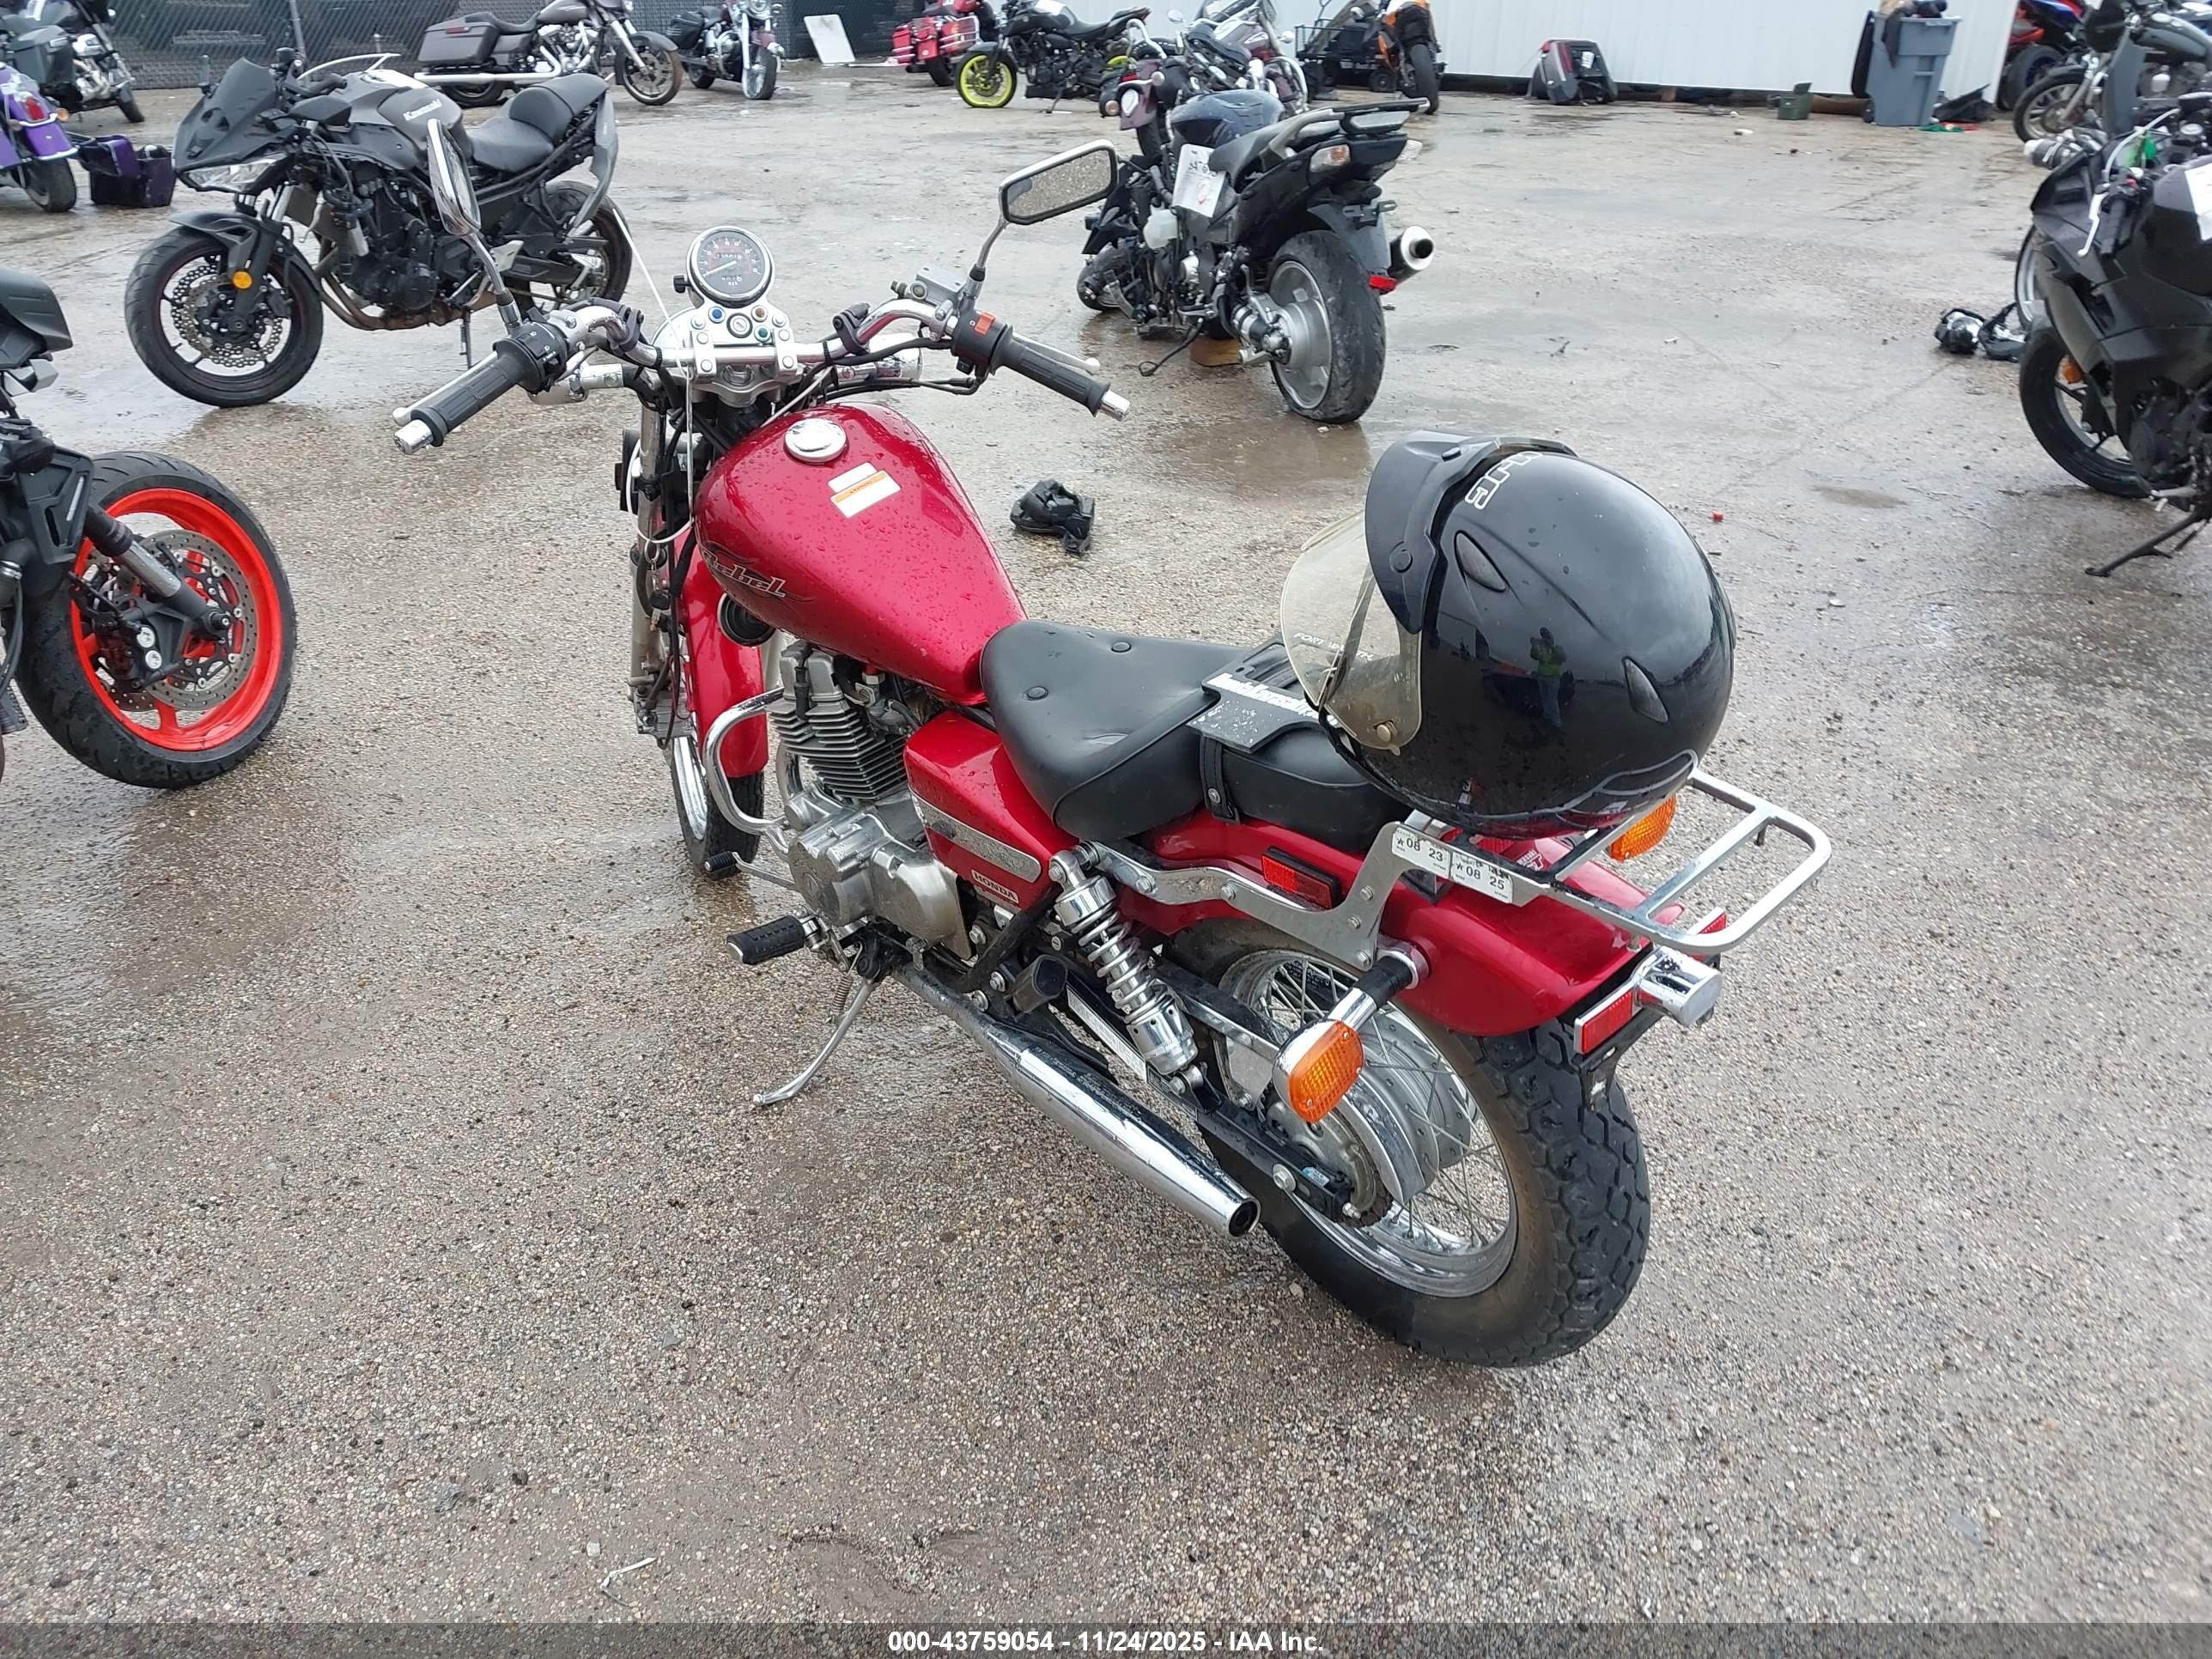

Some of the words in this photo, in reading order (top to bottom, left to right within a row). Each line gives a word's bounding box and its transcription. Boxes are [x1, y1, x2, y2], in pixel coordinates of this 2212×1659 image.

[702, 544, 787, 598] Rebel
[1407, 837, 1420, 852] 08
[1429, 848, 1443, 862] 23
[974, 872, 1018, 902] HONDA
[1466, 866, 1481, 880] 08
[1489, 876, 1505, 890] 25
